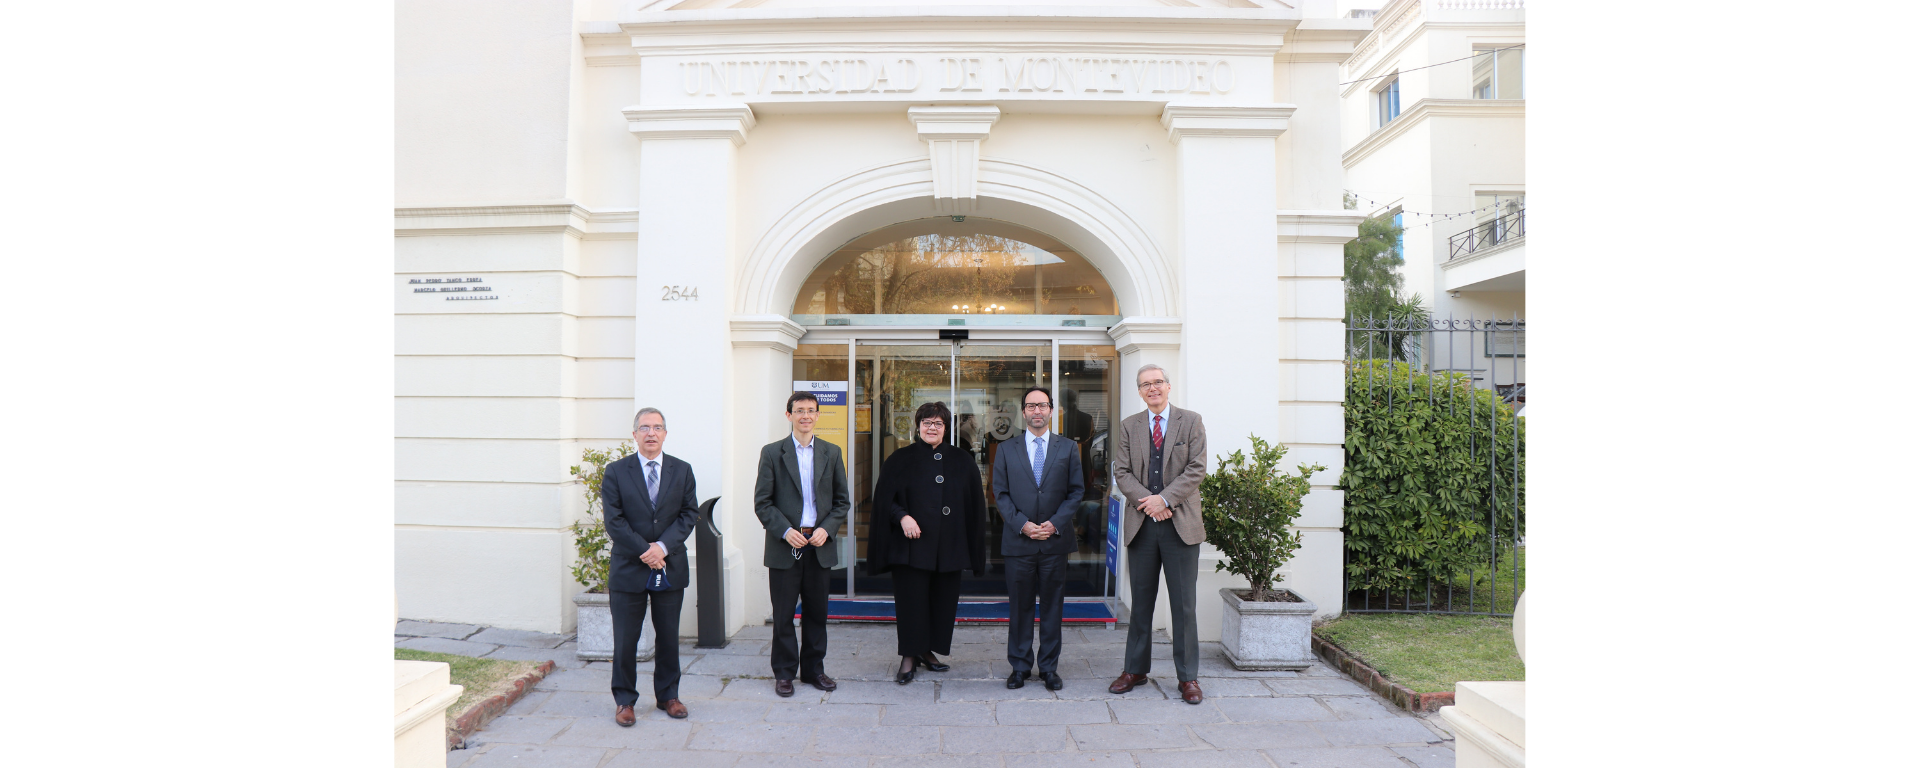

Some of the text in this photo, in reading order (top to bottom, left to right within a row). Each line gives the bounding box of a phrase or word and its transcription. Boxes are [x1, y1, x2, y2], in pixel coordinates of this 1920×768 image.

[679, 56, 1237, 97] UNIVERSIDAD DE MONTEVIDEO
[661, 285, 700, 302] 2544
